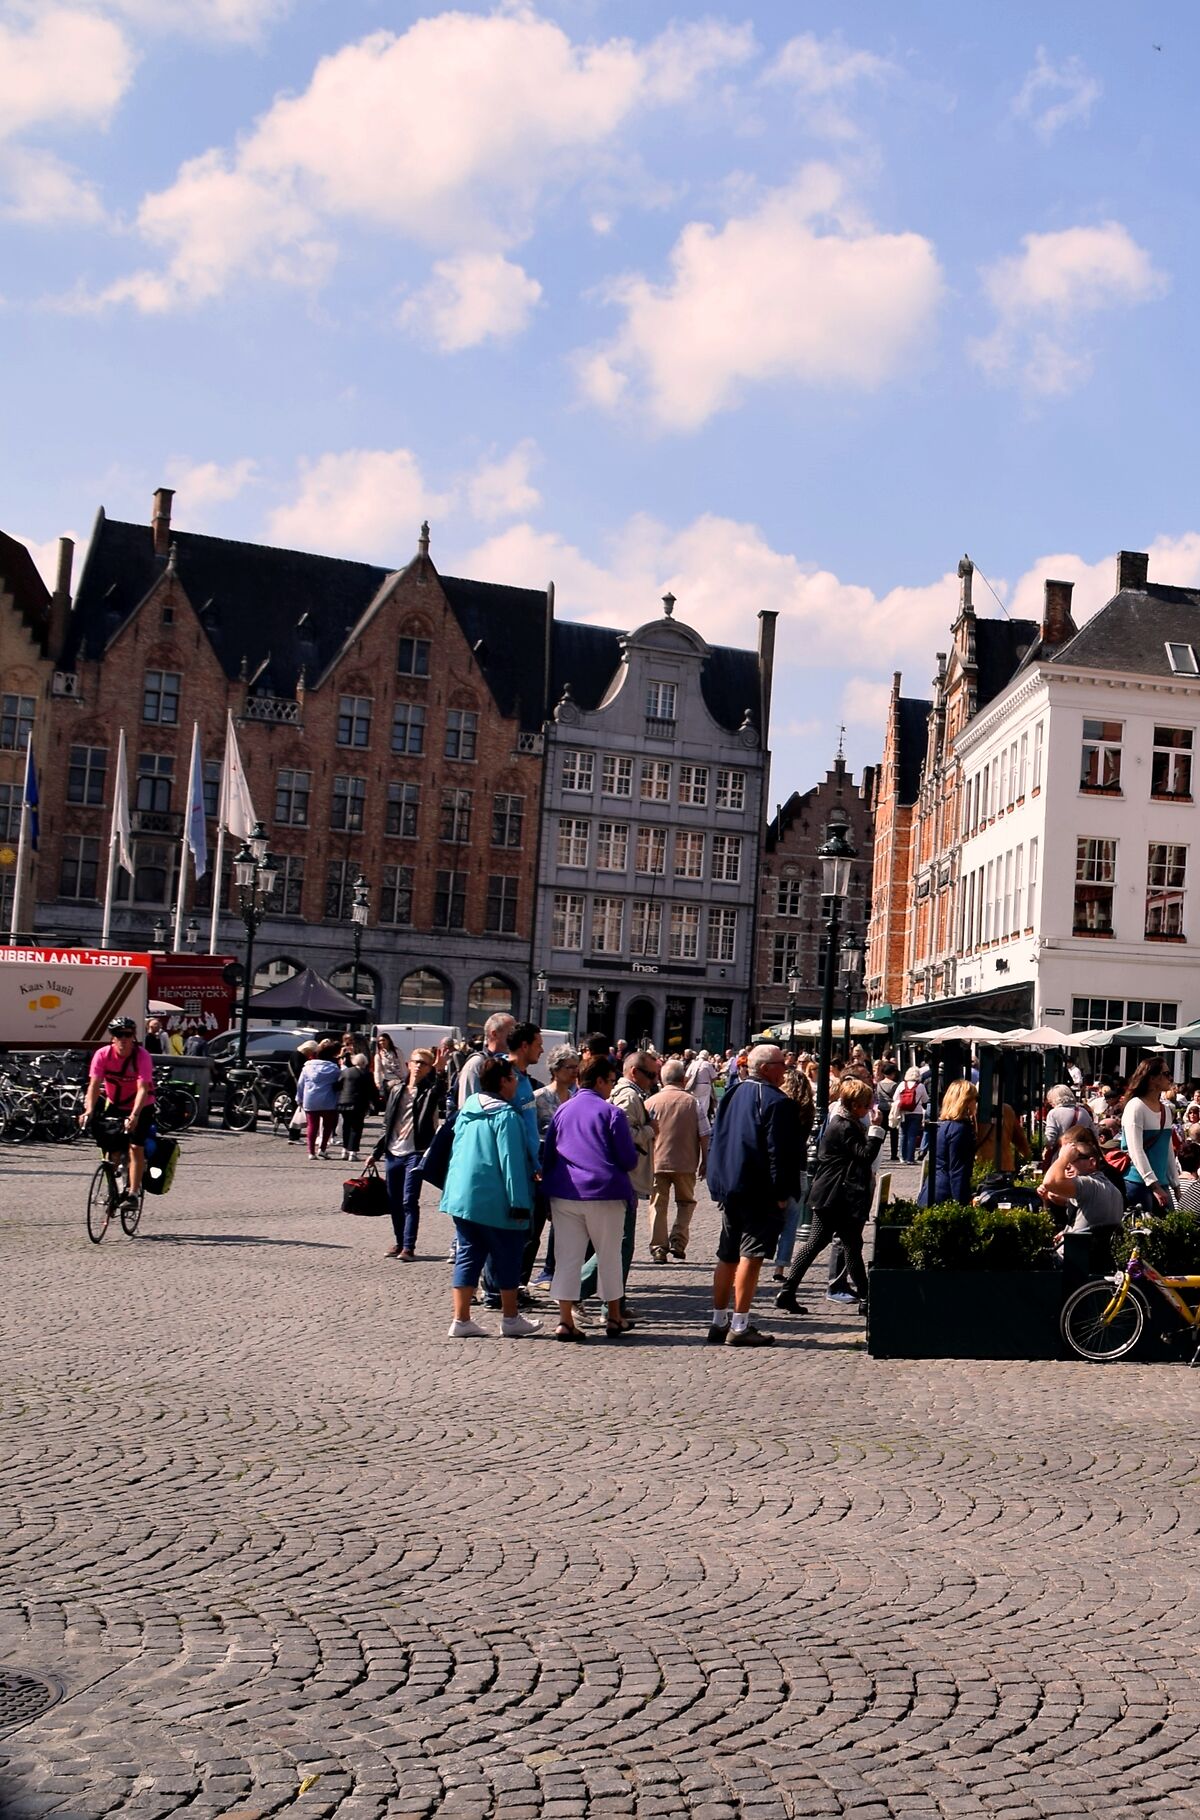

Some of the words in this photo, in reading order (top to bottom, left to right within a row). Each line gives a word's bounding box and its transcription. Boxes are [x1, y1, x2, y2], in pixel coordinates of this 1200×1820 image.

[49, 952, 81, 965] AAN
[632, 962, 659, 974] fnac
[20, 982, 44, 995] Kaas
[46, 980, 74, 996] Manil
